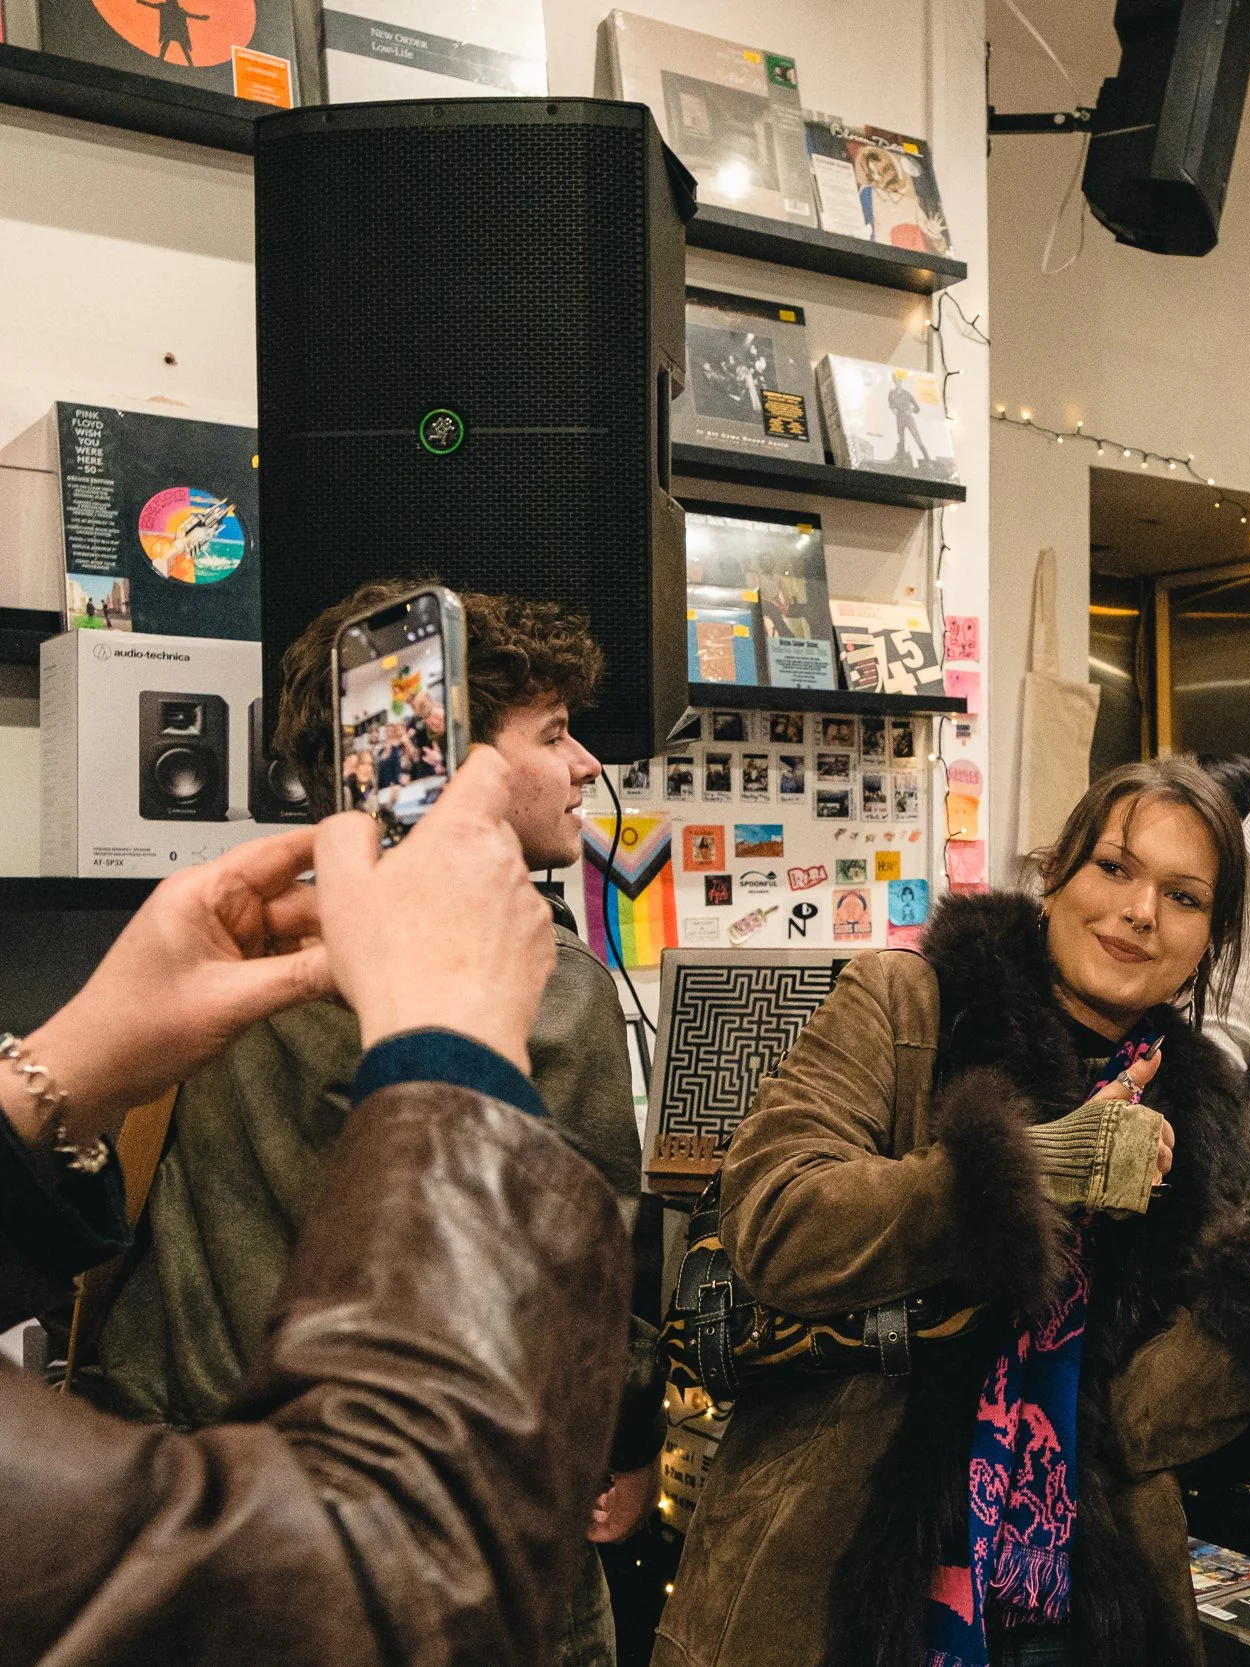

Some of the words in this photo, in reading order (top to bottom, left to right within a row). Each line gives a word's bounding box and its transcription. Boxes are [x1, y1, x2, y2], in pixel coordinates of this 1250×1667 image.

[76, 409, 99, 420] PINK
[72, 418, 104, 430] FLOYD
[75, 427, 102, 438] WISH
[78, 437, 100, 447] YOU
[75, 446, 104, 457] WERE
[77, 455, 103, 467] HERE
[114, 648, 191, 662] audio-technica
[740, 880, 778, 888] SPOONFUL
